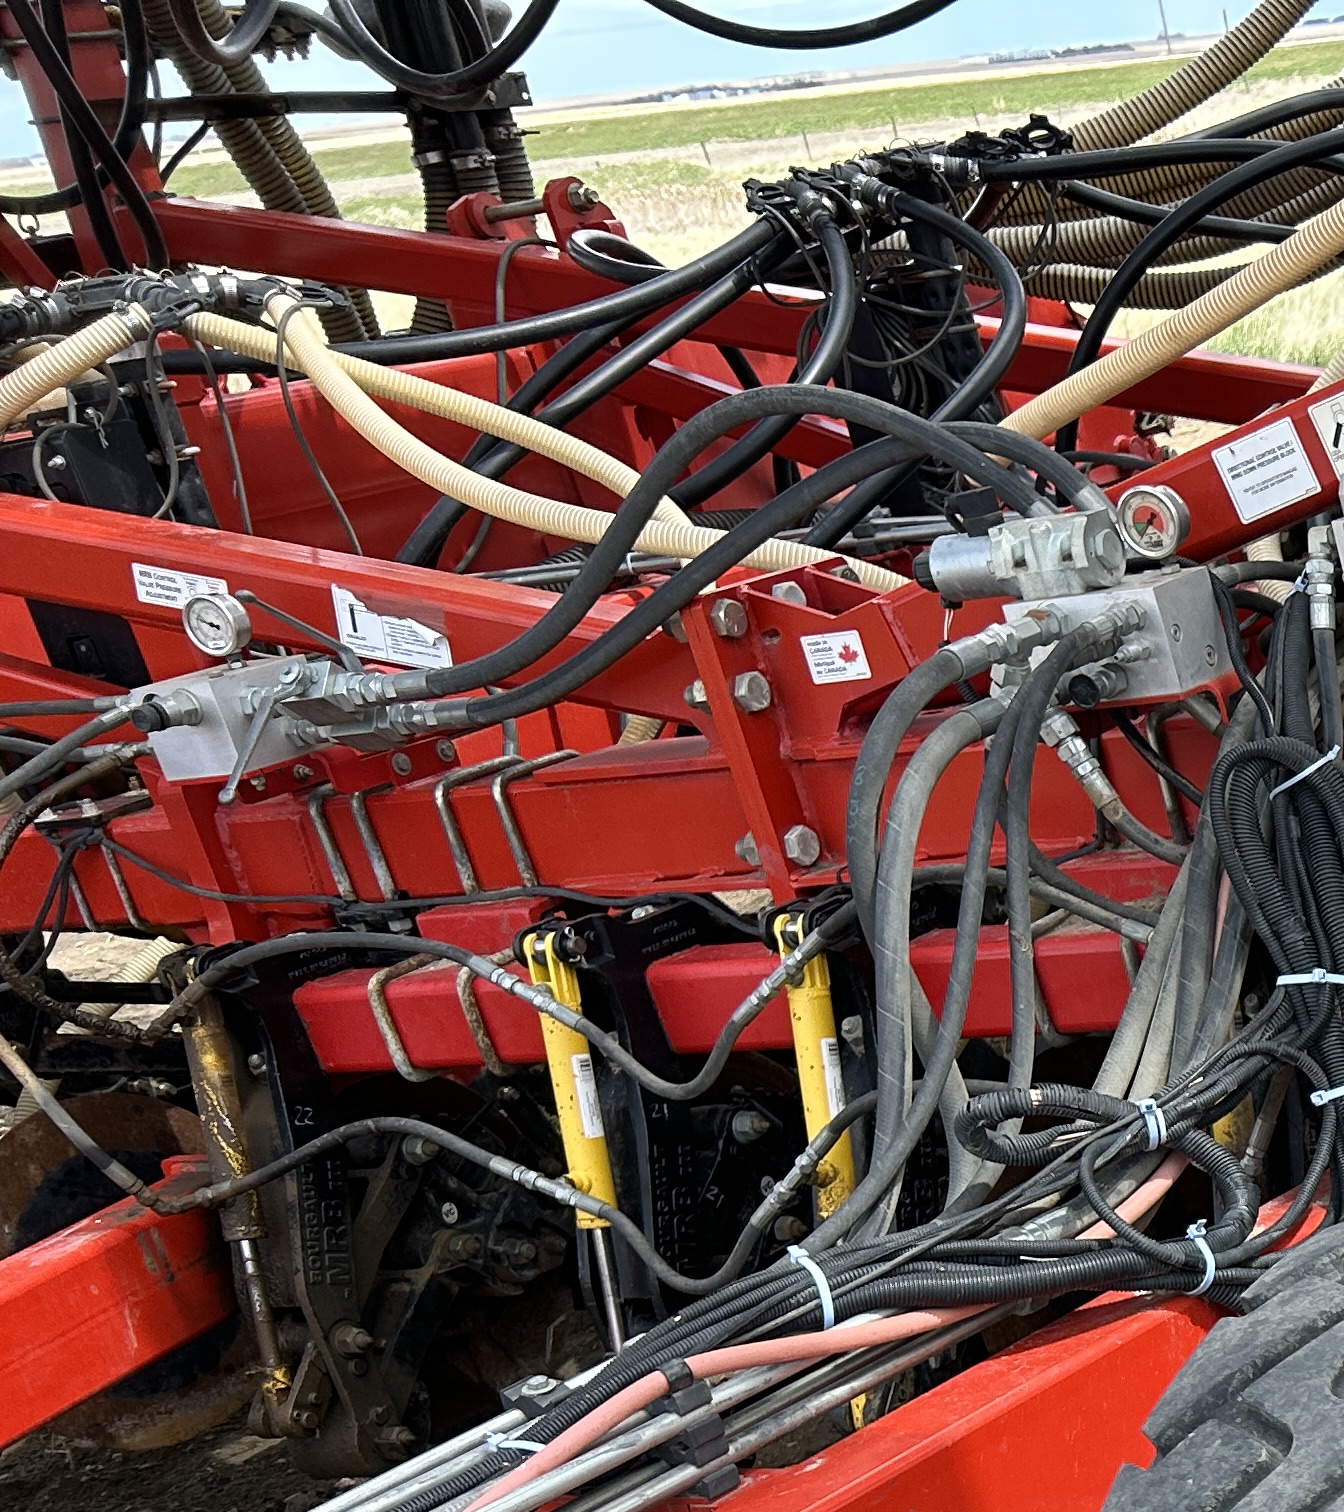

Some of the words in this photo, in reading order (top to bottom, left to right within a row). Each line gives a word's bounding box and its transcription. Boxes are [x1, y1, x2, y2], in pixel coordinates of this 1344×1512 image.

[294, 1105, 315, 1126] 22
[651, 1102, 669, 1121] 21
[654, 1143, 672, 1258] OURGAULT
[321, 1200, 353, 1286] MRB
